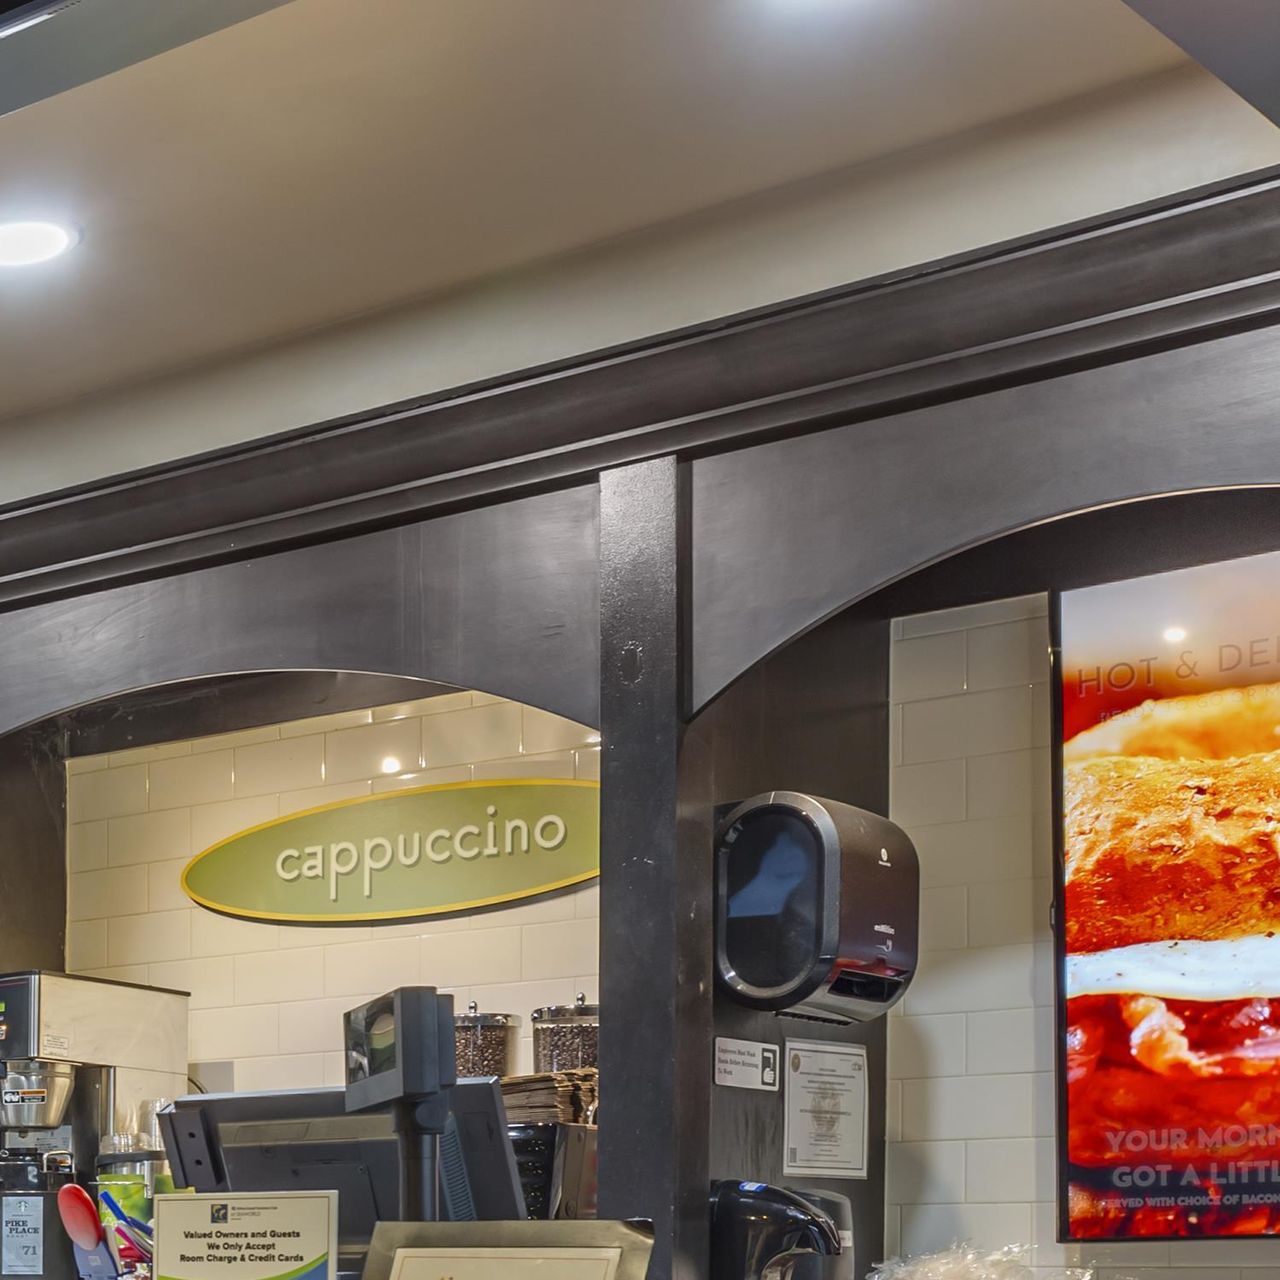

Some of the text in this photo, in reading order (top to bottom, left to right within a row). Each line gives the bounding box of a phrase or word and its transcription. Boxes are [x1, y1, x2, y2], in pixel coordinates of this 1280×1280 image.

[1078, 656, 1159, 697] HOT
[1175, 650, 1199, 680] &
[276, 805, 566, 901] cappuccino
[1105, 1128, 1189, 1152] YOUR
[1112, 1159, 1280, 1188] GOT A LITTL
[1145, 1196, 1176, 1207] WITH
[1177, 1194, 1222, 1206] CHOICE
[1223, 1193, 1238, 1205] OF
[183, 1229, 301, 1239] Valued Owners and Guests
[22, 1245, 37, 1256] 71
[207, 1241, 276, 1253] We Only Accept
[179, 1253, 304, 1264] Room Charge & Credit Cards
